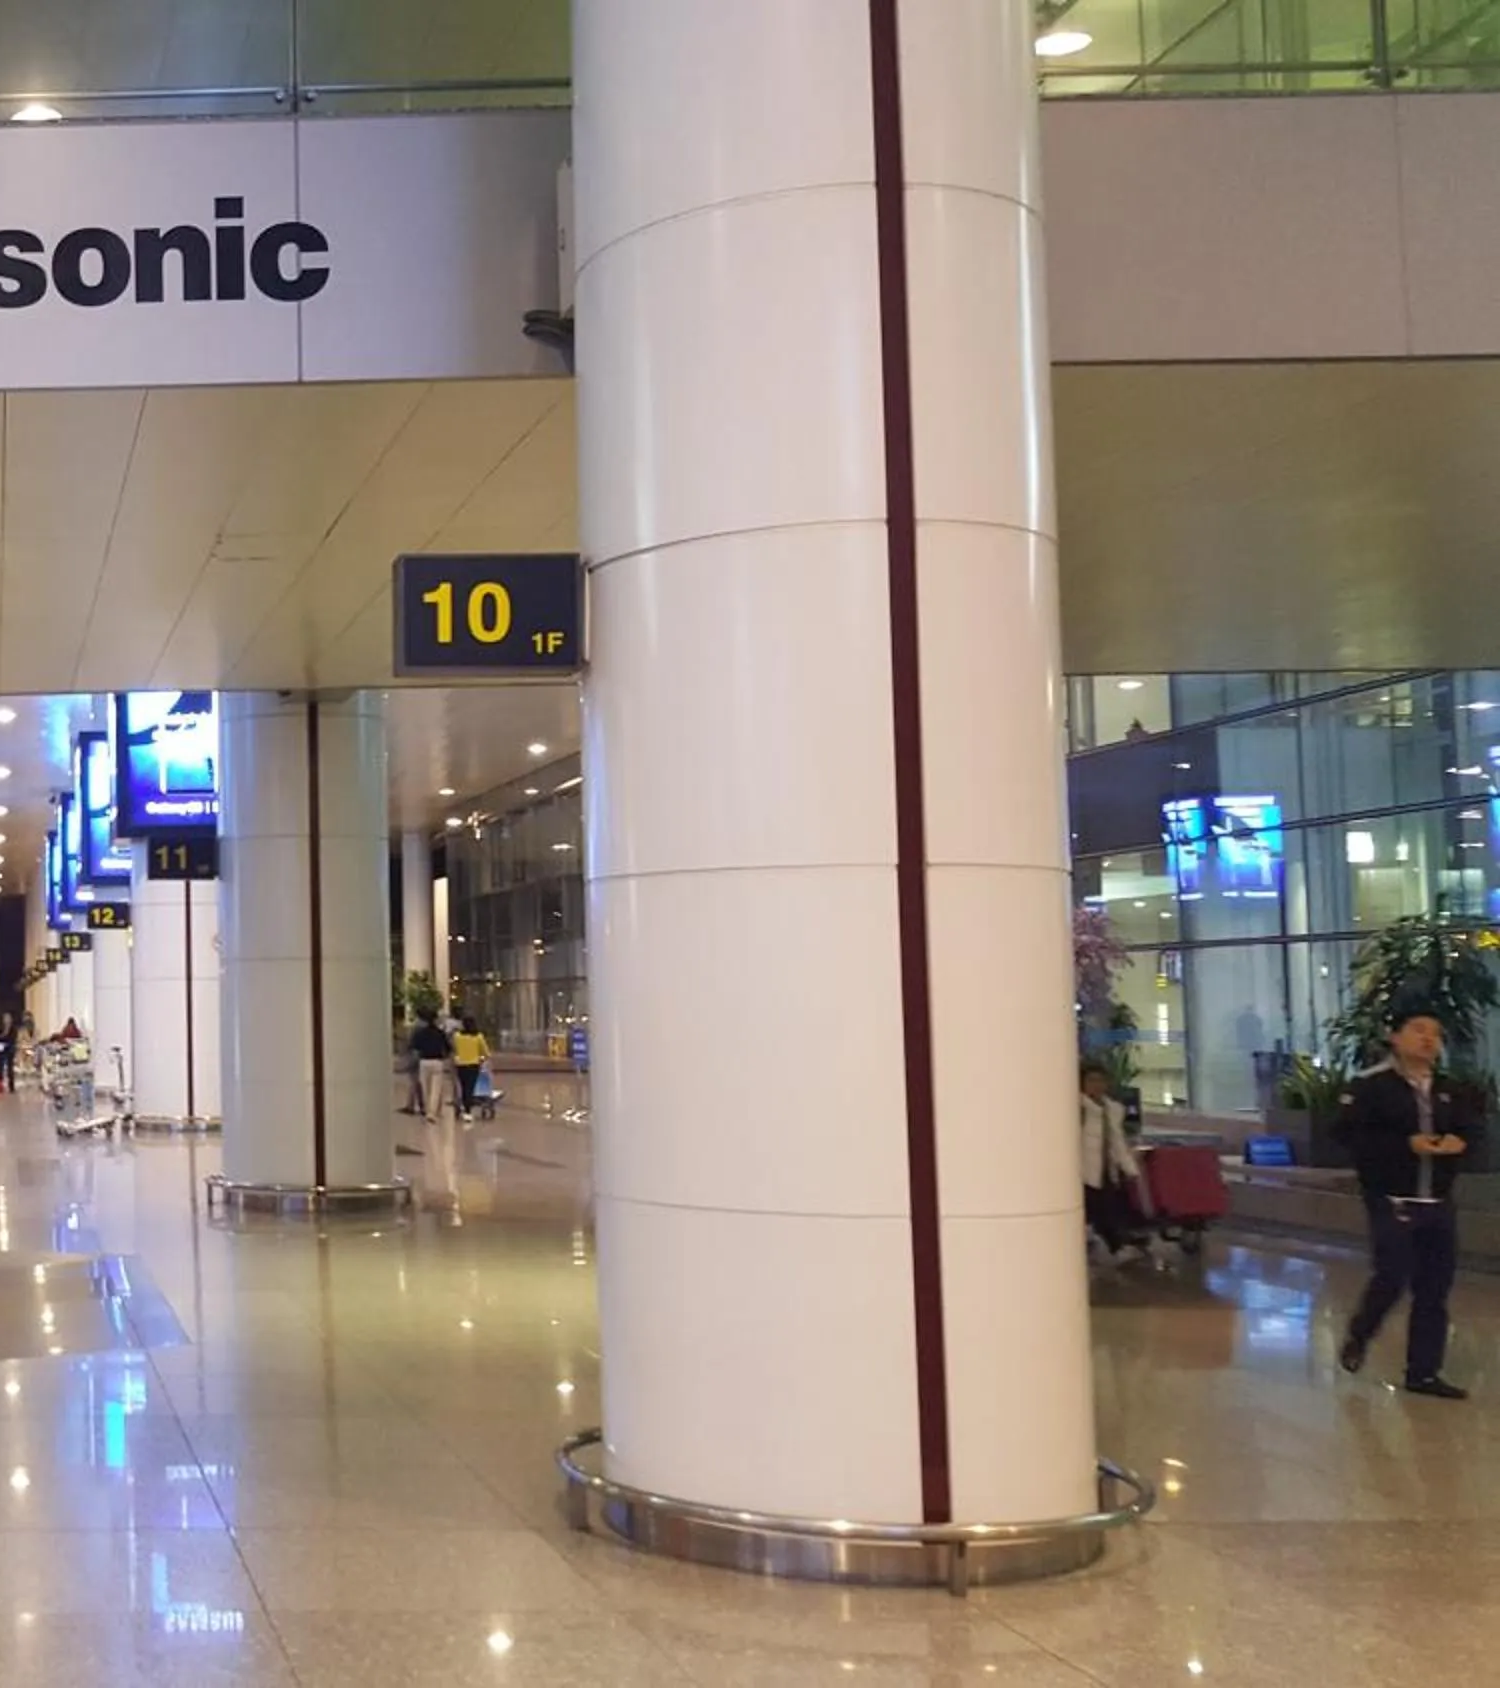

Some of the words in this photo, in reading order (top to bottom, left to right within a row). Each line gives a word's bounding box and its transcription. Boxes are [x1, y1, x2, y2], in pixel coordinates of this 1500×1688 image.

[422, 581, 512, 644] 10
[531, 631, 565, 654] 1F
[155, 844, 187, 871] 11
[91, 906, 115, 925] 12
